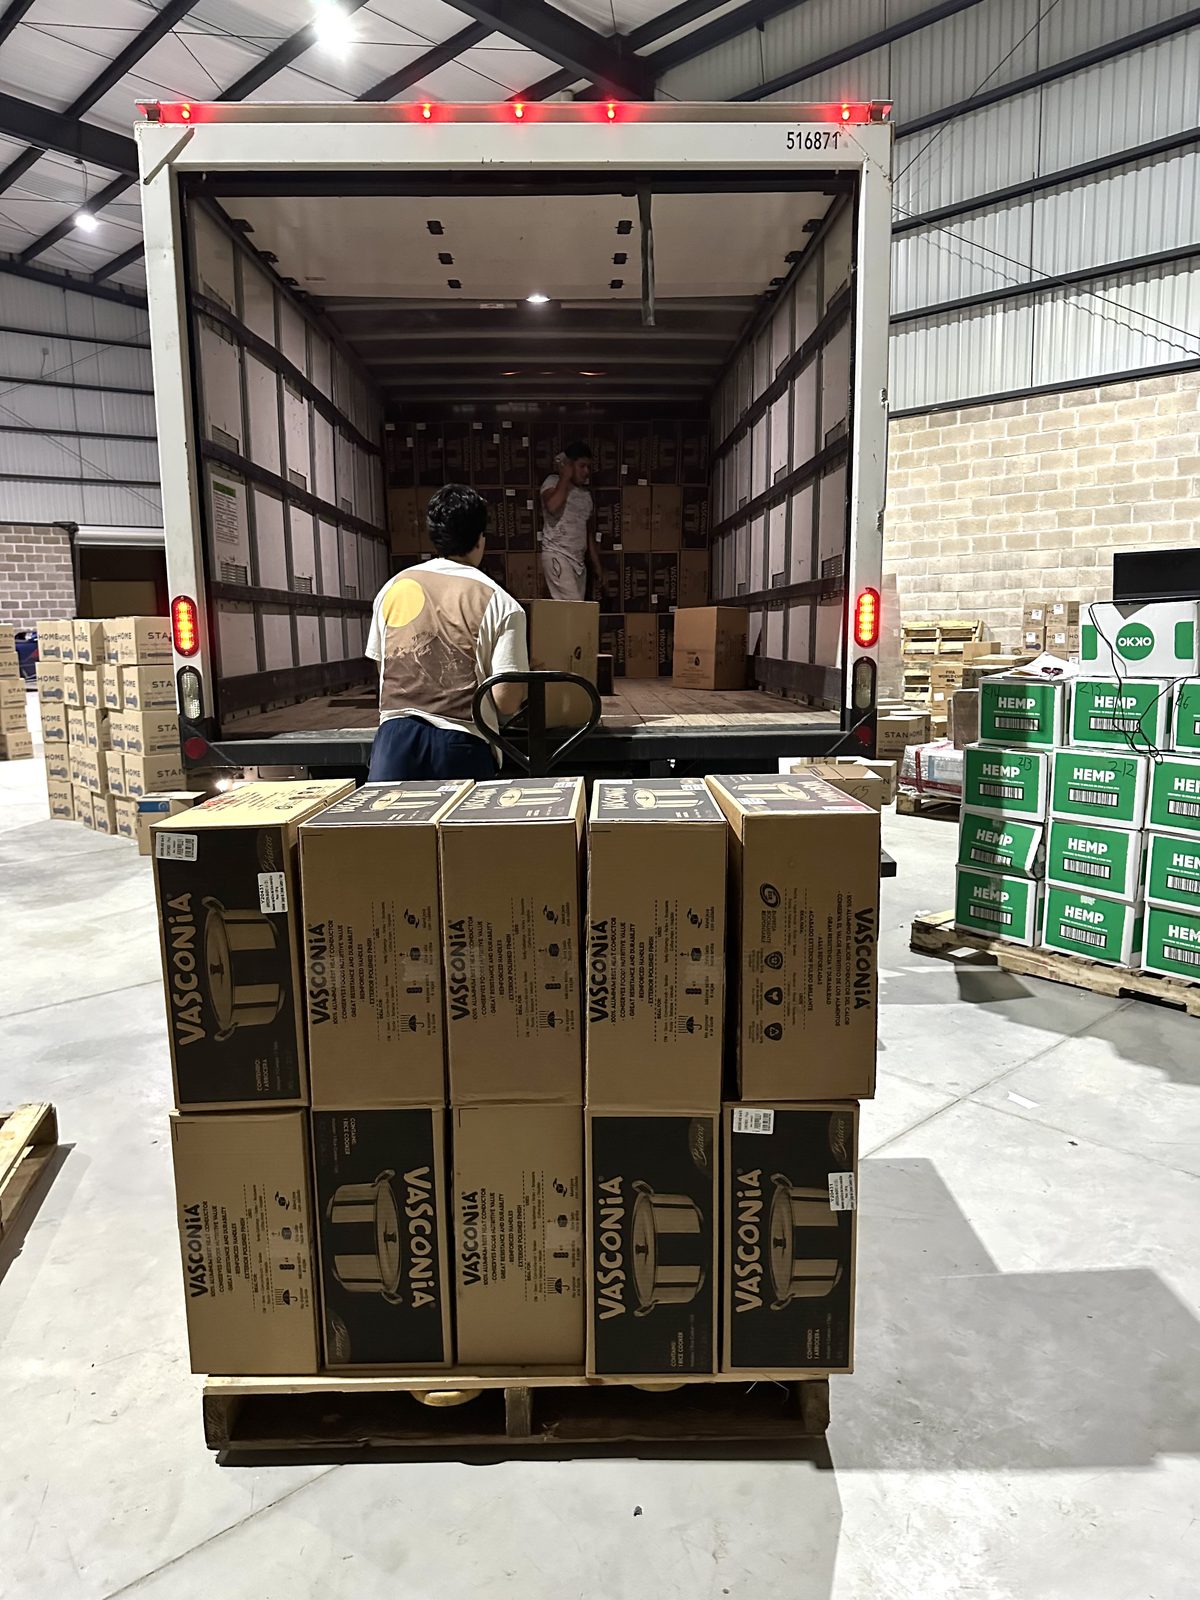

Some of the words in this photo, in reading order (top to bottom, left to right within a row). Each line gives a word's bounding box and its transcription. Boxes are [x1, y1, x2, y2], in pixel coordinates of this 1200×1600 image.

[786, 131, 838, 150] 516871
[148, 632, 171, 640] STA
[152, 681, 174, 689] STA
[998, 696, 1036, 710] HEMP
[1094, 695, 1137, 710] HEMP
[157, 724, 178, 732] STA
[982, 763, 1020, 778] HEMP
[1073, 767, 1116, 783] HEMP
[976, 828, 1013, 847] HEMP
[1068, 837, 1108, 855] HEMP
[973, 886, 1010, 903] HEMP
[1064, 905, 1105, 925] HEMP
